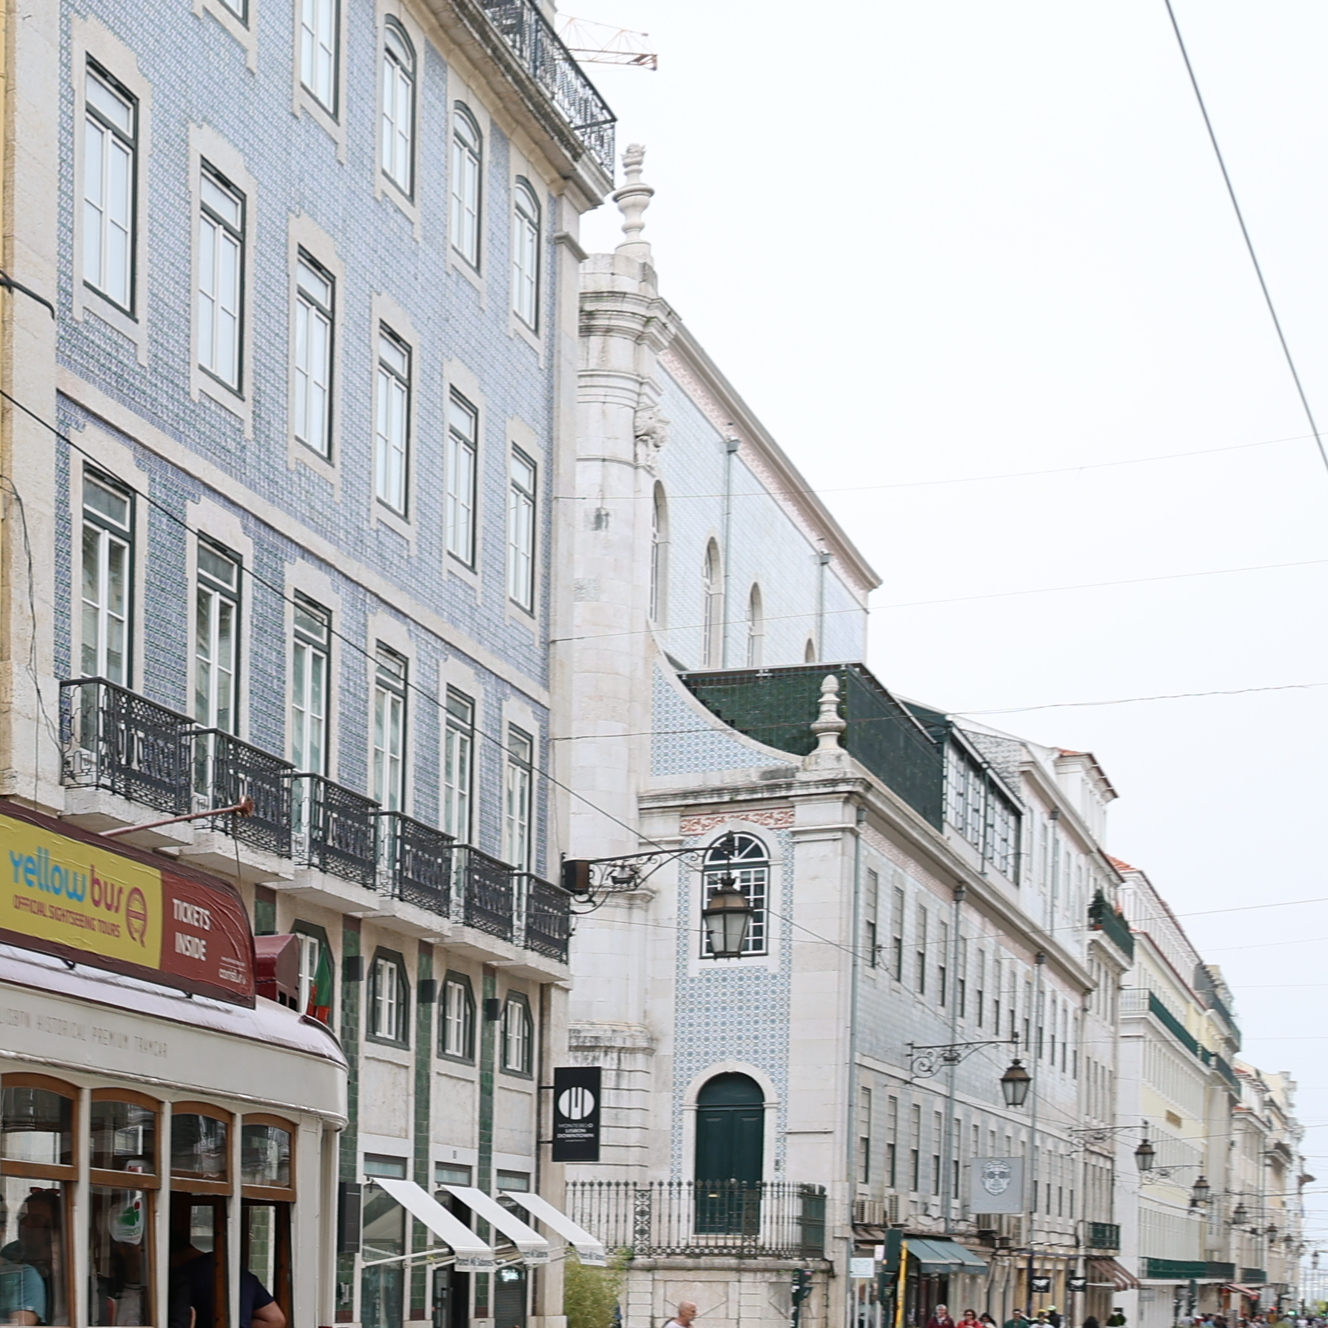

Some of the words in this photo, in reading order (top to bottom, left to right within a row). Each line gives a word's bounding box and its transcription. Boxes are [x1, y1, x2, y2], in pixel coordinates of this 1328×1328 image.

[9, 846, 88, 903] yellow
[90, 864, 124, 914] bus
[13, 894, 47, 917] OFFICIAL
[48, 901, 97, 931] SIGHTSEEING
[97, 919, 121, 938] TOURS
[172, 898, 211, 932] TICKETS
[175, 931, 207, 962] INSIDE
